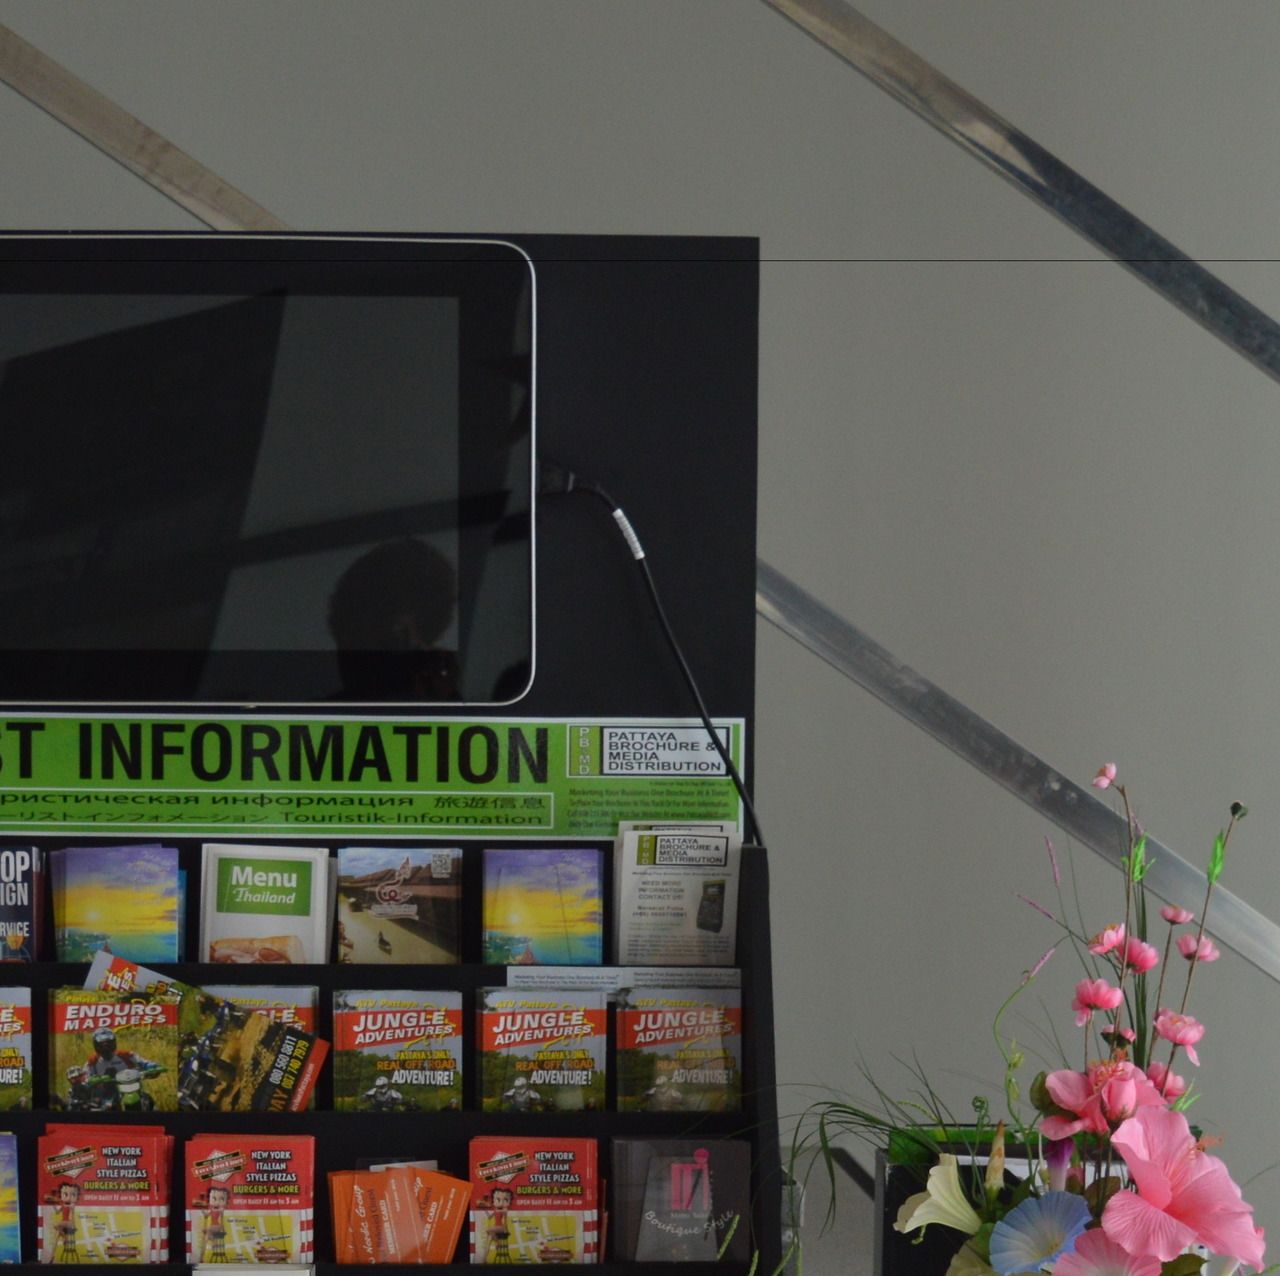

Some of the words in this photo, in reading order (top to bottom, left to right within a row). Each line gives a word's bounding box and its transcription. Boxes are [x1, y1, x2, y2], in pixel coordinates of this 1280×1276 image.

[608, 731, 677, 741] PATTAYA
[79, 721, 549, 784] INFORMATION
[608, 741, 700, 751] BROCHURE
[608, 751, 660, 761] MEDIA
[608, 761, 722, 771] DISTRIBUTION
[231, 865, 297, 888] Menu
[233, 889, 296, 906] Thailand
[66, 1004, 162, 1020] ENDURO
[64, 1014, 167, 1031] MADNESS
[353, 1011, 445, 1032] JUNGLE
[493, 1012, 584, 1032] JUNGLE
[355, 1025, 454, 1044] ADVENTURES
[494, 1024, 593, 1045] ADVENTURES
[391, 1069, 454, 1085] ADVENTURE!
[120, 1169, 147, 1178] PIZZAS
[644, 1209, 701, 1236] Boutique
